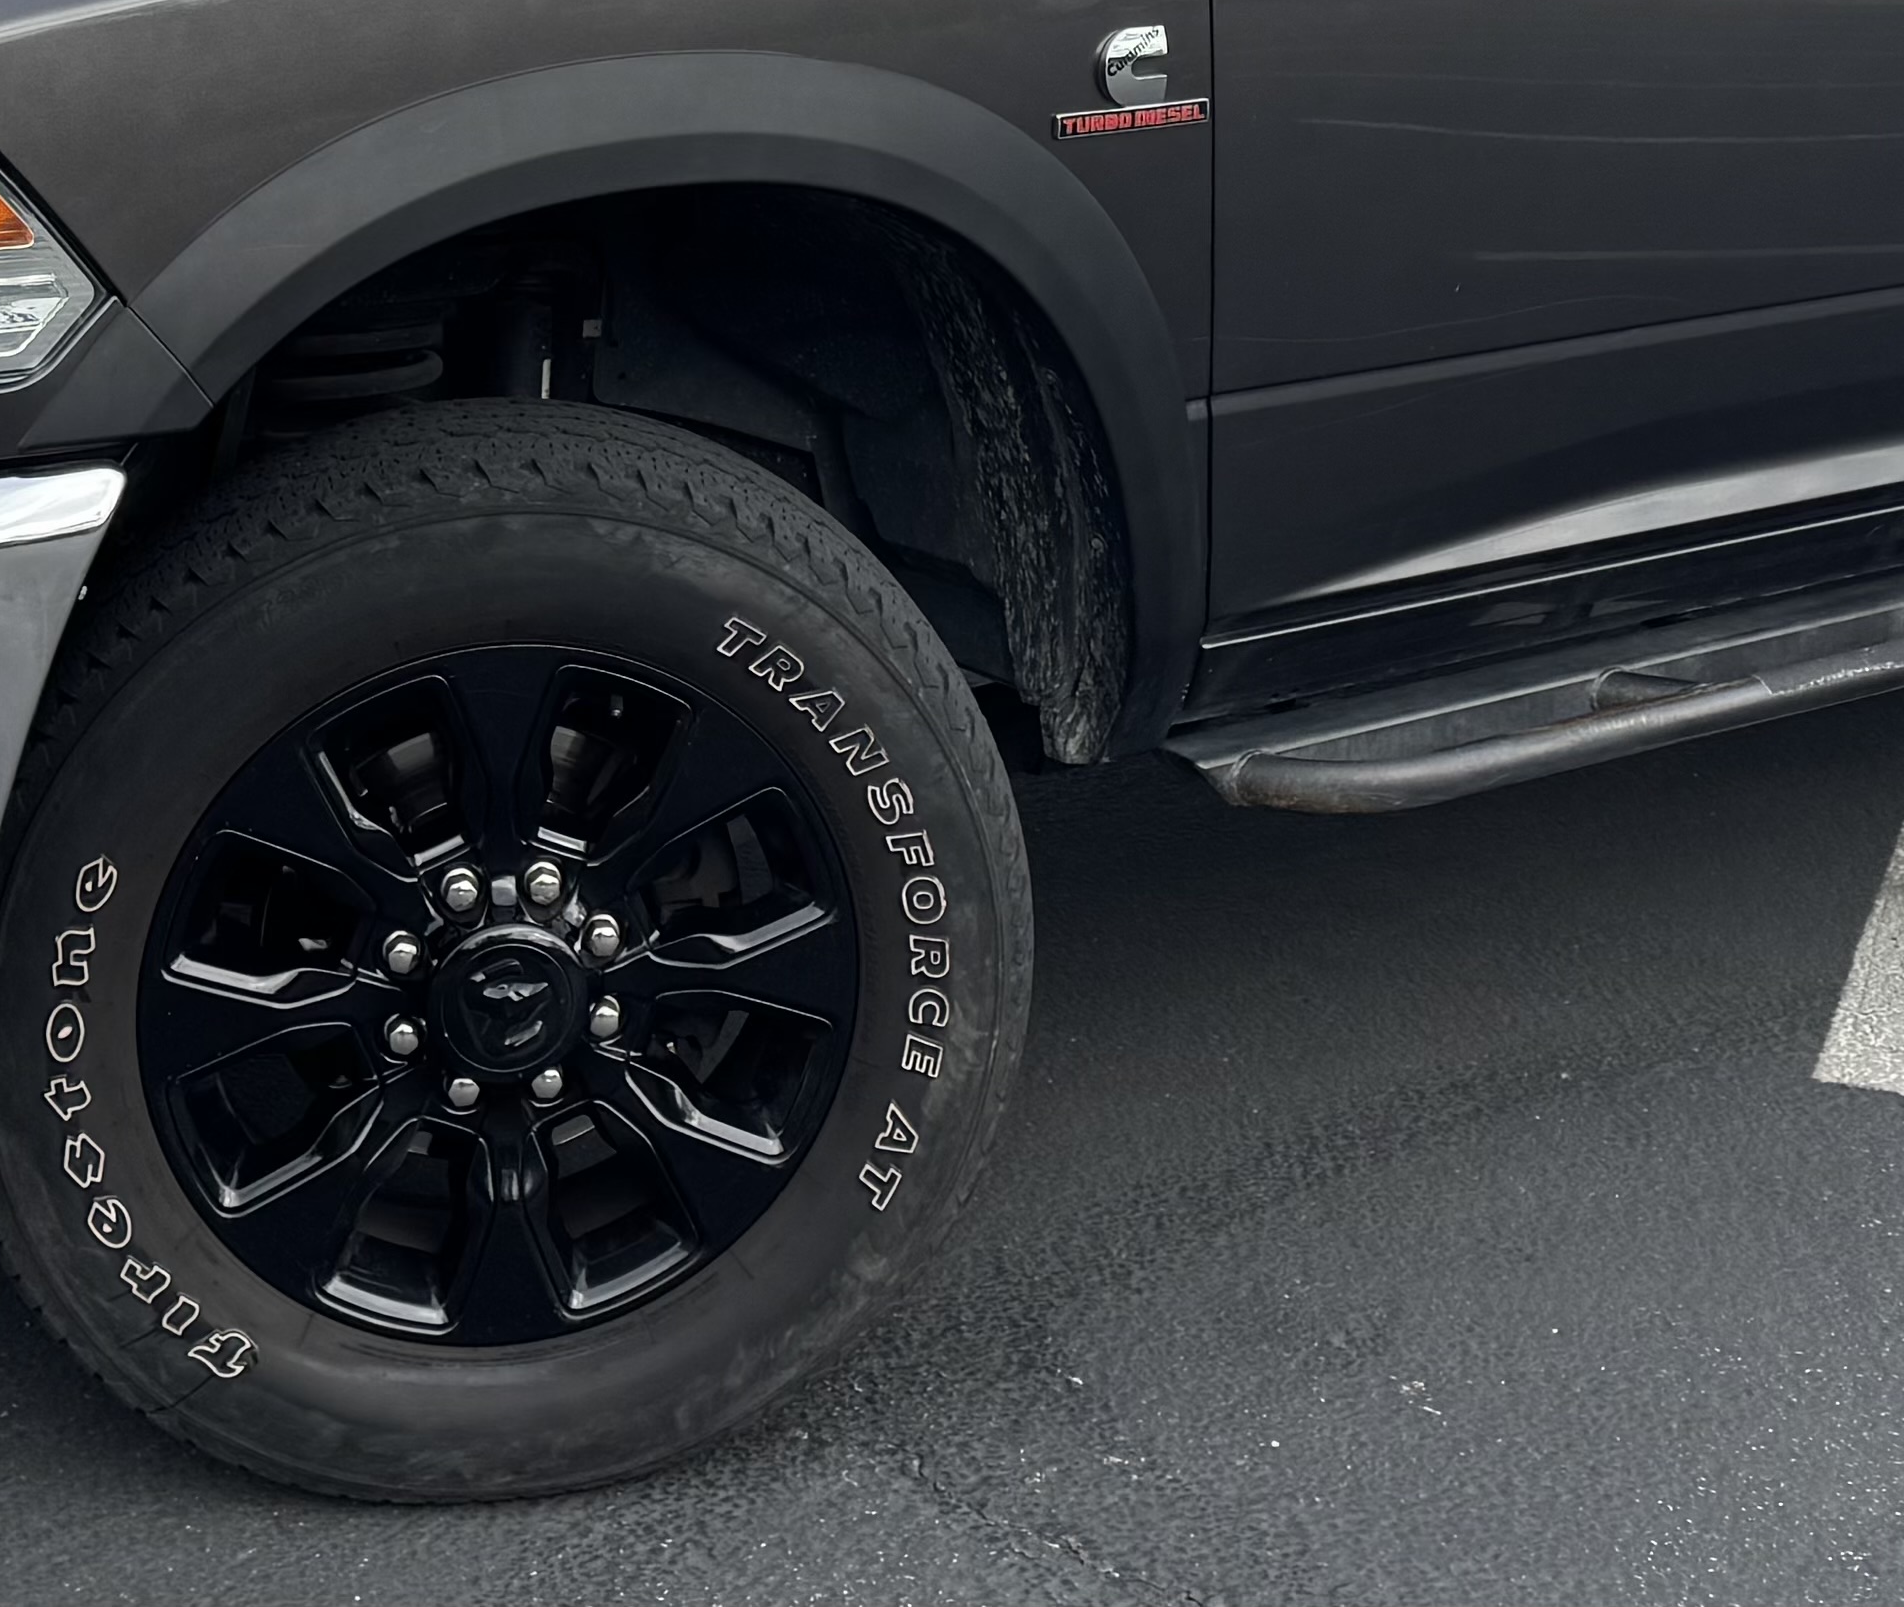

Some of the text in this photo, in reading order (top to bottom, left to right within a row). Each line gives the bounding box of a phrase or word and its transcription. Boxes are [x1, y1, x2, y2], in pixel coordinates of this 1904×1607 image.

[1063, 105, 1205, 134] TURBO DIESEL
[45, 856, 257, 1378] Firestone
[716, 616, 949, 1211] TRANSFORCE AT
